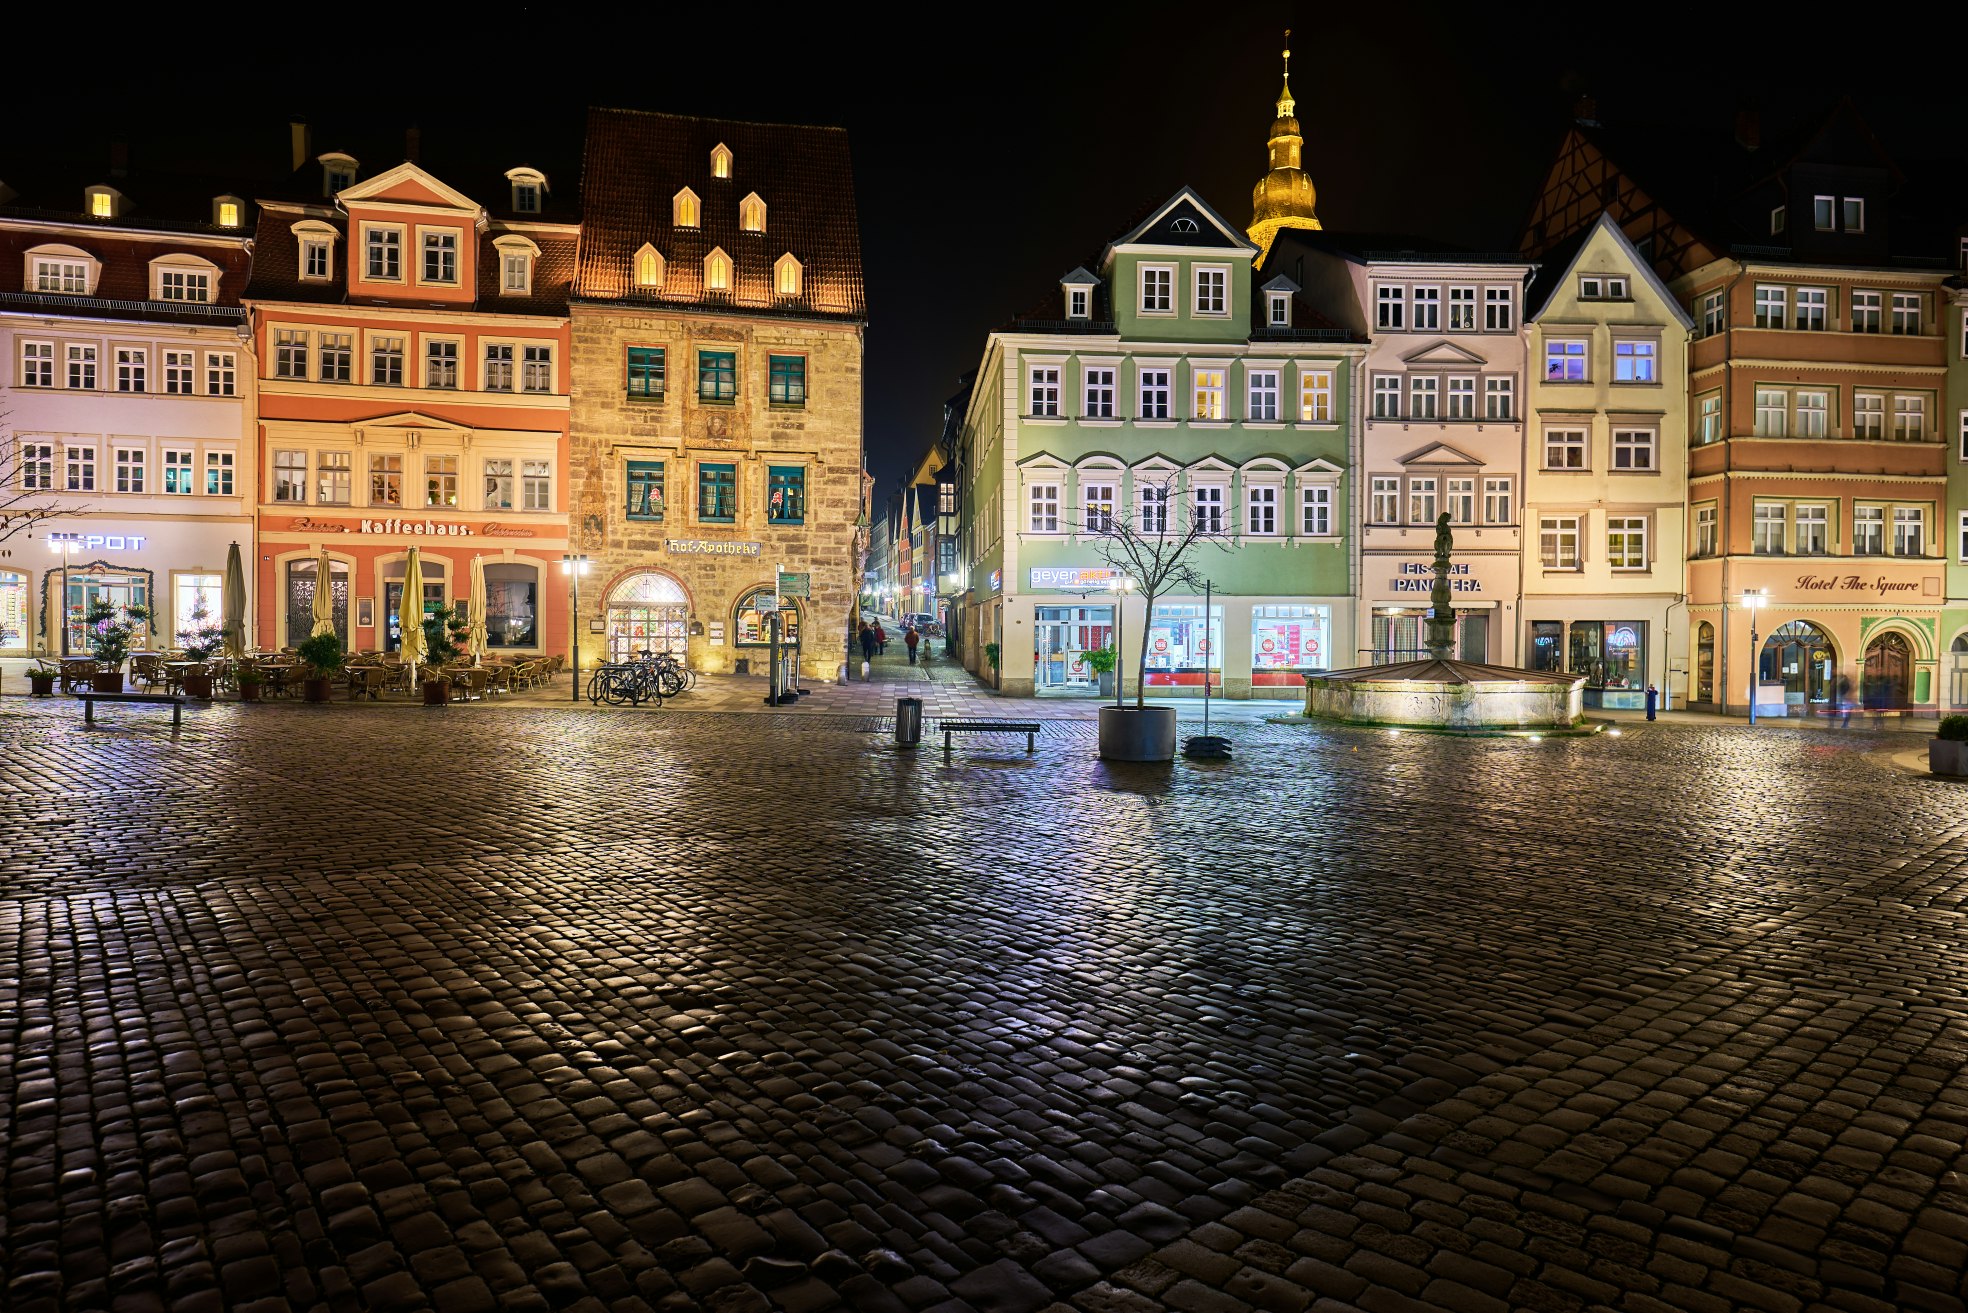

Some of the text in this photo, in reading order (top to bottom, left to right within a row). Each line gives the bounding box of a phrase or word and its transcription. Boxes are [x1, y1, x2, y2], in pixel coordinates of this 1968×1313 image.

[48, 534, 146, 551] POT
[670, 540, 757, 555] Hof-Apotheke
[1031, 569, 1112, 583] geyer akti
[1396, 579, 1483, 592] PANERA
[1795, 575, 1919, 596] Hotel The Square
